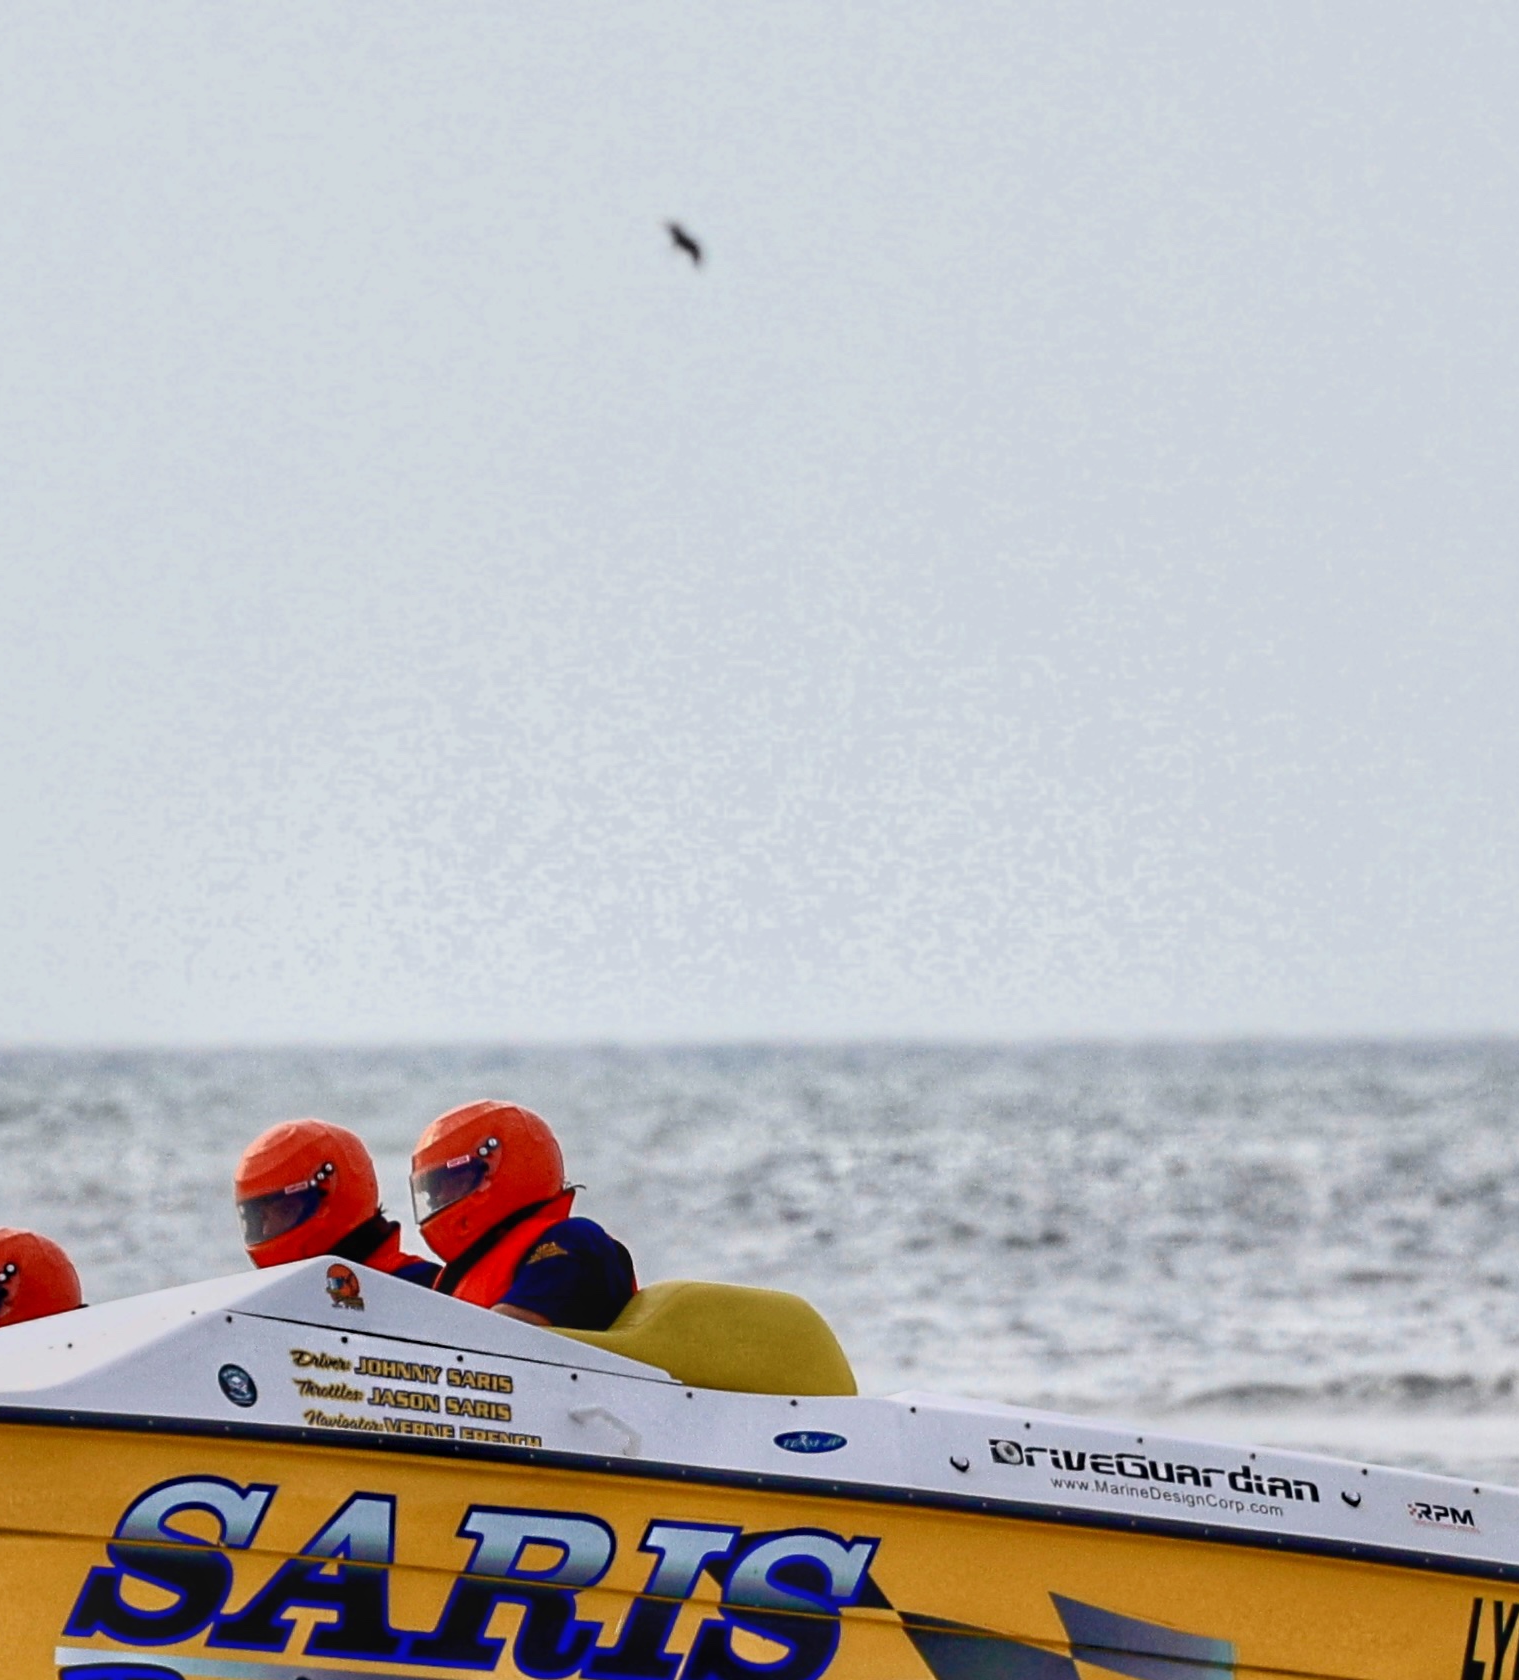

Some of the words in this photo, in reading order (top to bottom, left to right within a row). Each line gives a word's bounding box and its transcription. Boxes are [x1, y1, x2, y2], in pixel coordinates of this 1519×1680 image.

[354, 1356, 442, 1384] JOHNNY
[446, 1368, 513, 1394] SARIS
[367, 1387, 440, 1412] JASON
[445, 1397, 511, 1422] SARIS
[383, 1417, 455, 1438] VERNE
[1050, 1476, 1284, 1517] www.MarineDesignCorp.com
[1414, 1502, 1475, 1527] RPM
